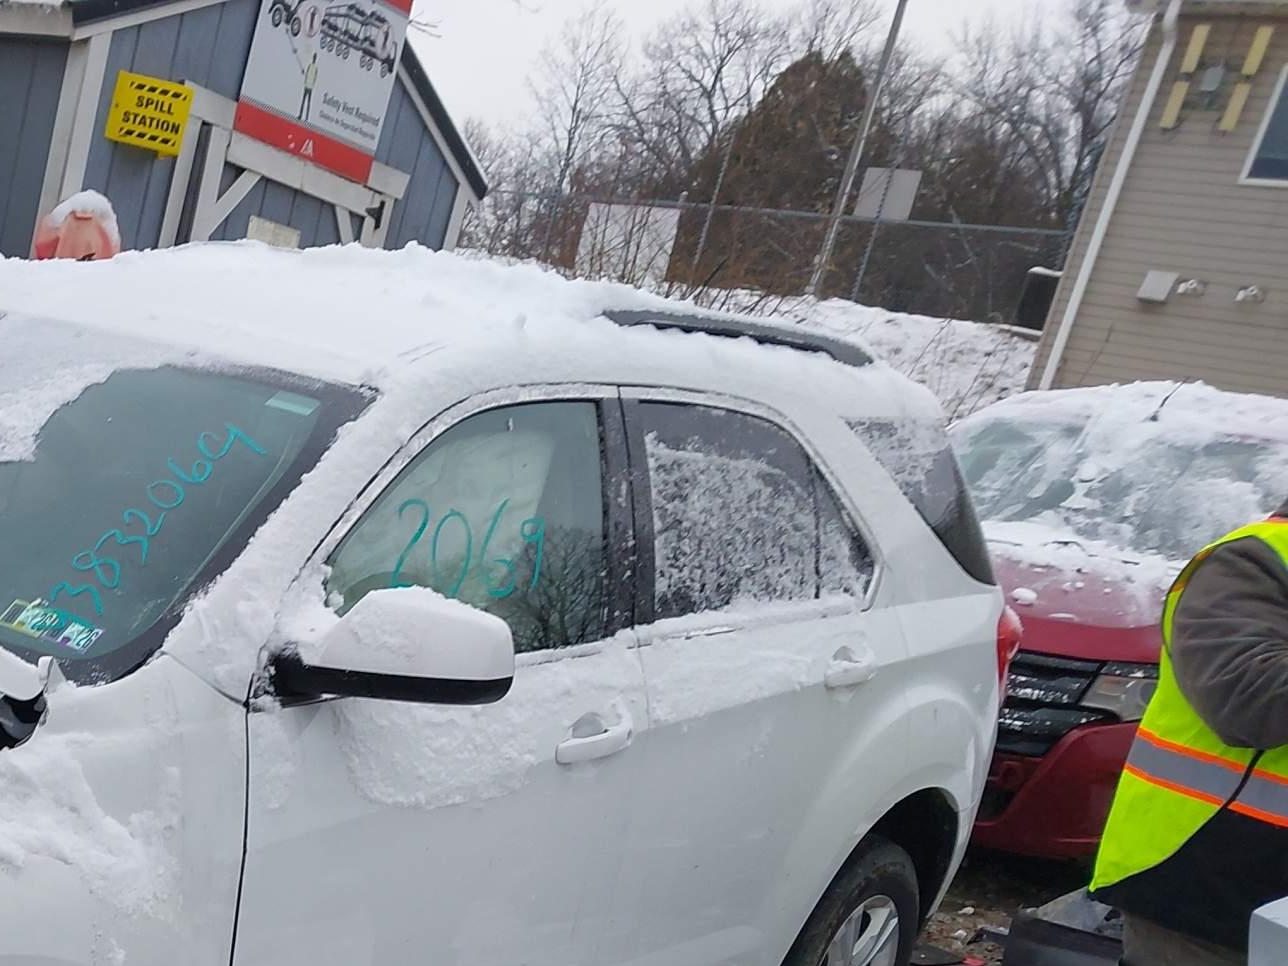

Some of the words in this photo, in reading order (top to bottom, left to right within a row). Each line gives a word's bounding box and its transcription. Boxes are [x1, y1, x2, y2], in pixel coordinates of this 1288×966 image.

[136, 95, 175, 116] SPILL
[121, 111, 181, 136] STATION
[390, 497, 546, 600] 2069
